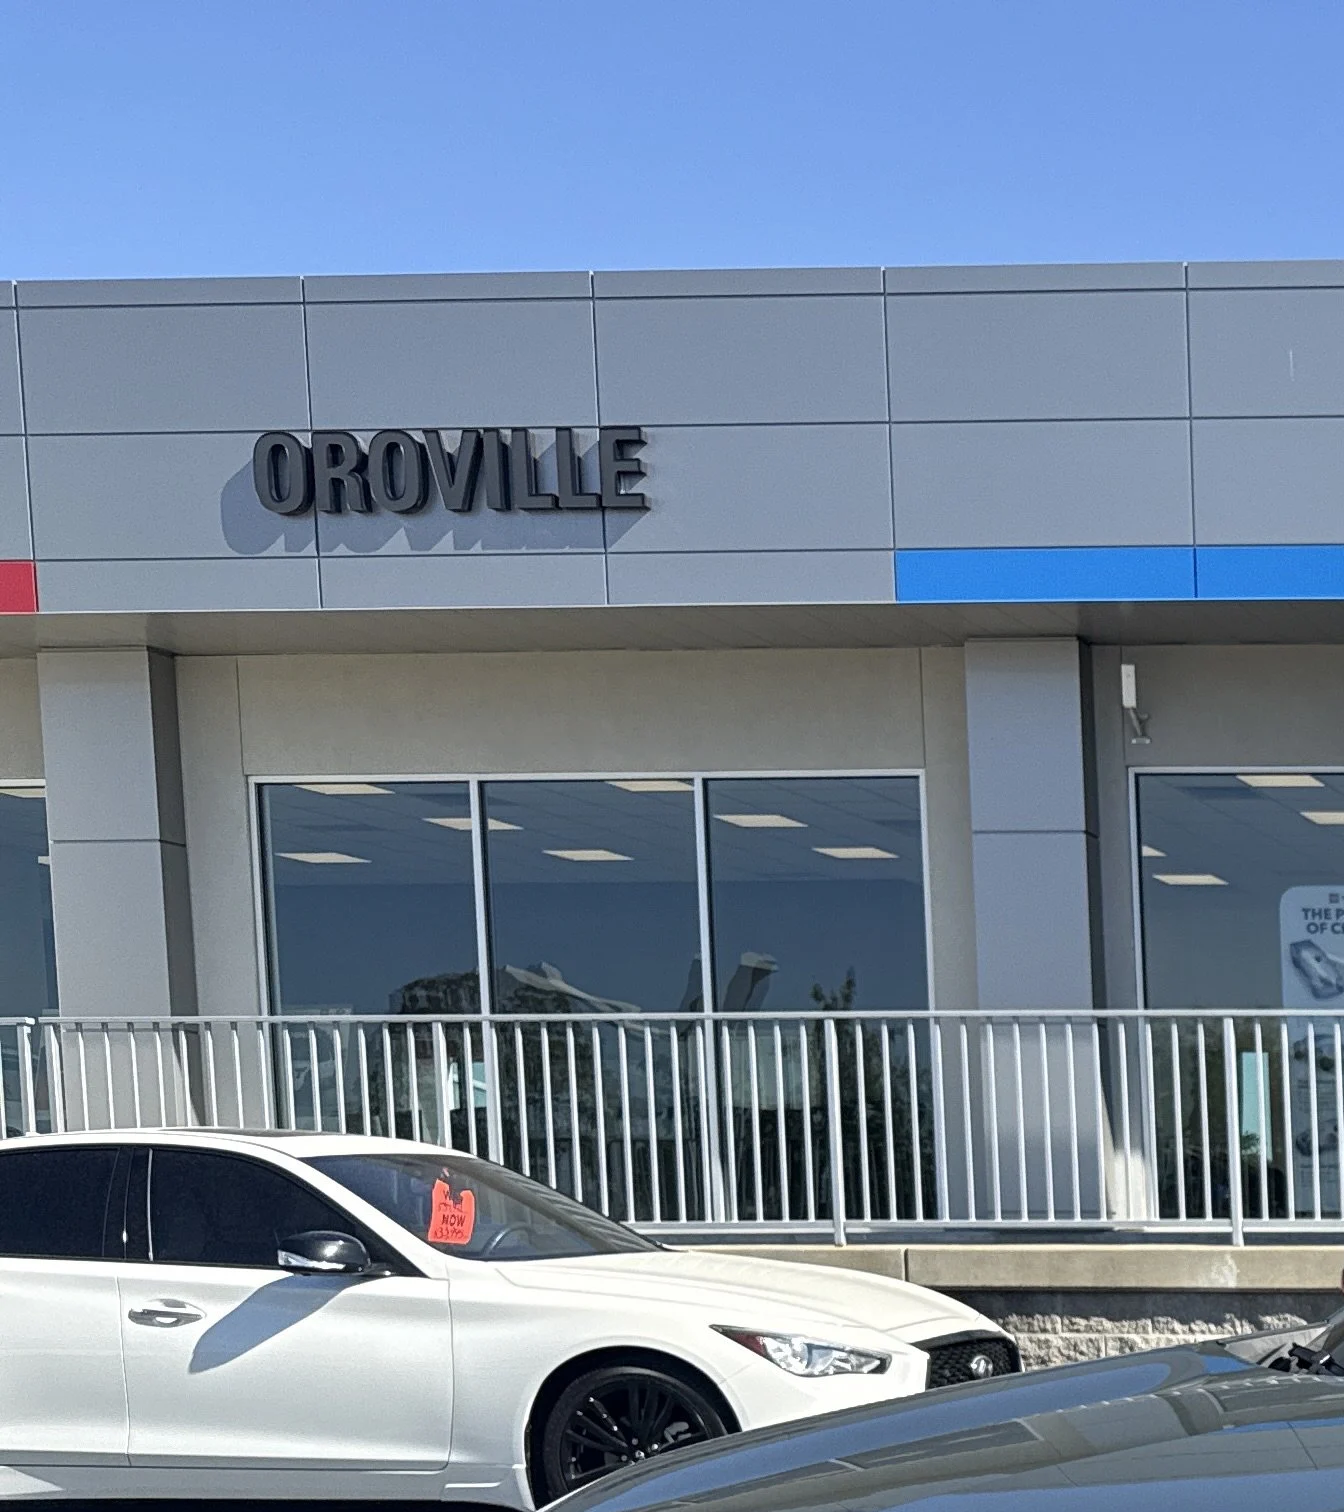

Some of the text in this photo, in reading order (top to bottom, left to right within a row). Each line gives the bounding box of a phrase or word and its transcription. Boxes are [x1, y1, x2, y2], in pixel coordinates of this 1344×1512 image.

[252, 426, 652, 515] OROVILLE
[1302, 908, 1332, 920] THE
[1306, 922, 1328, 935] OF
[442, 1214, 466, 1227] NOW
